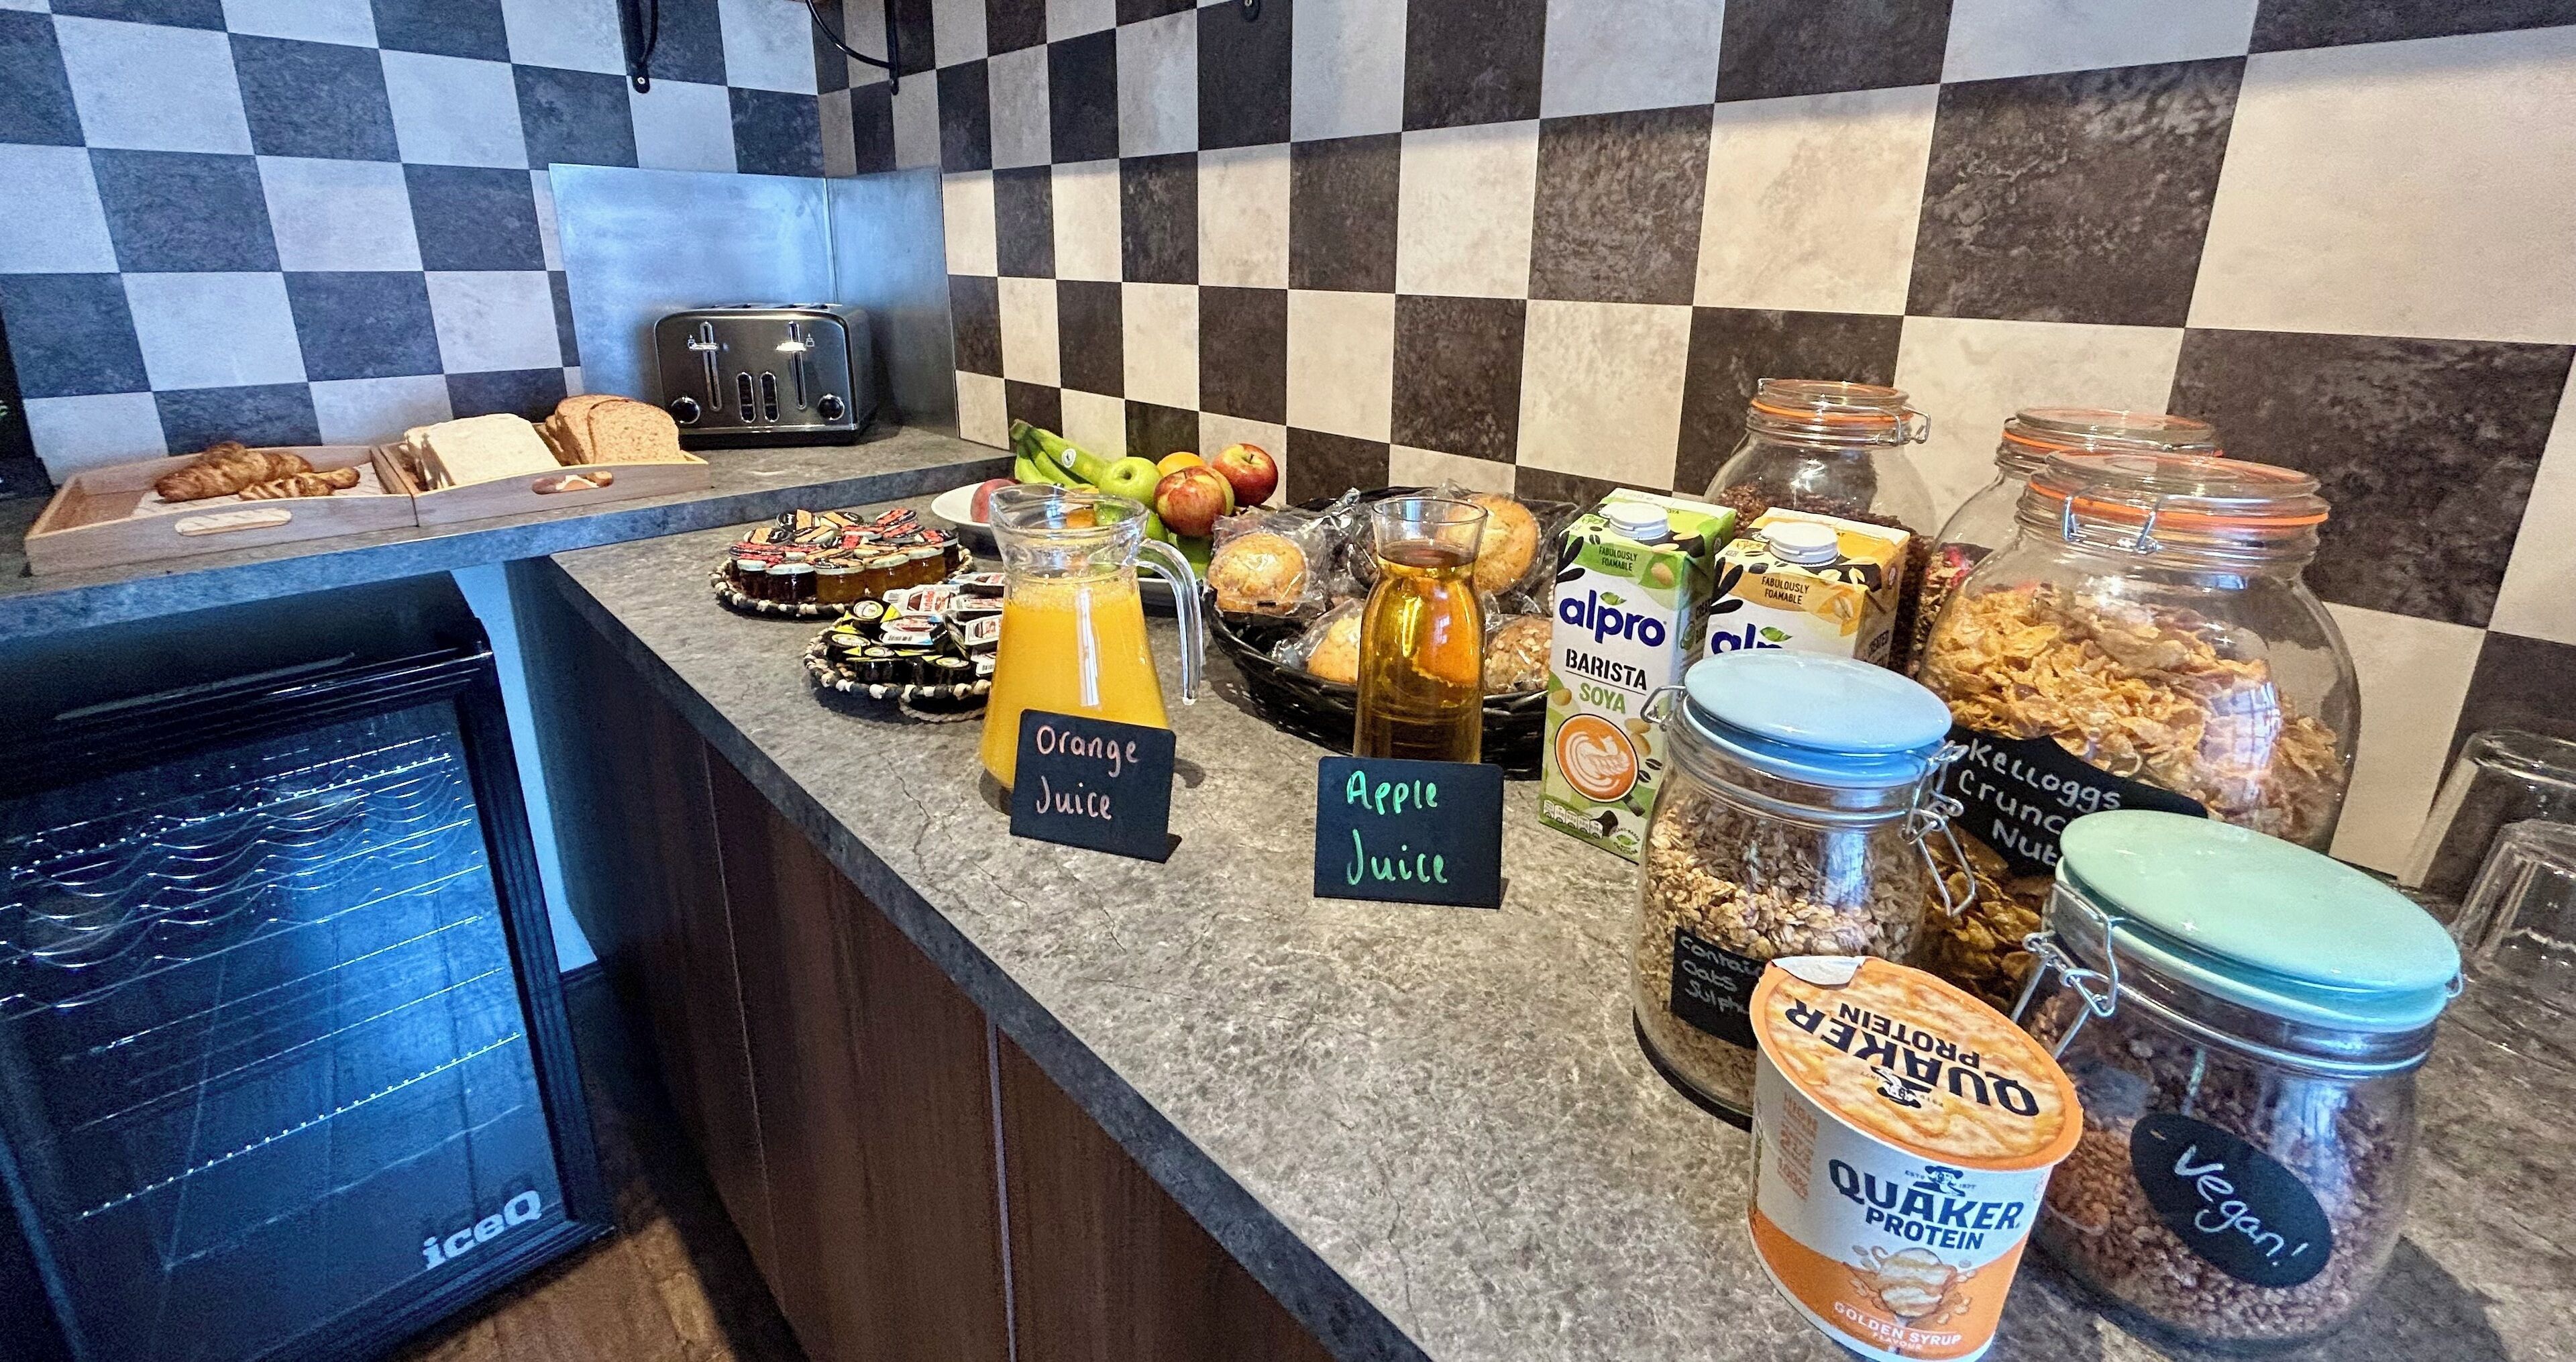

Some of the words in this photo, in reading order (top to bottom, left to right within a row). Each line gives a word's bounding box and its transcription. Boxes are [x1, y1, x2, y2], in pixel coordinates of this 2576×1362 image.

[1599, 545, 1638, 562] FABULOUSLY
[1601, 557, 1633, 572] FOAMABLE
[1761, 576, 1810, 594] FABULOUSLY
[1764, 590, 1803, 606] FOAMABLE
[1559, 589, 1666, 647] alpro
[1711, 623, 1782, 655] al
[1566, 648, 1647, 690] BARISTA
[1578, 682, 1626, 714] SOYA
[1036, 725, 1140, 778] Orange
[1036, 775, 1112, 820] Juice
[1346, 770, 1438, 815] Apple
[1958, 769, 2076, 835] Crunc
[1347, 829, 1448, 886] Juice
[1992, 819, 2059, 867] Nut
[1784, 998, 2039, 1117] QUAKER
[1838, 1002, 1980, 1069] PROTEIN
[1829, 1159, 2024, 1230] QUAKER
[2174, 1144, 2309, 1267] Vegan!
[423, 1190, 542, 1270] iceQ
[1866, 1206, 1984, 1249] PROTEIN
[1833, 1301, 1904, 1339] GOLDEN
[1909, 1332, 1962, 1345] SYRUP
[1872, 1332, 1923, 1350] FLAVOUR
